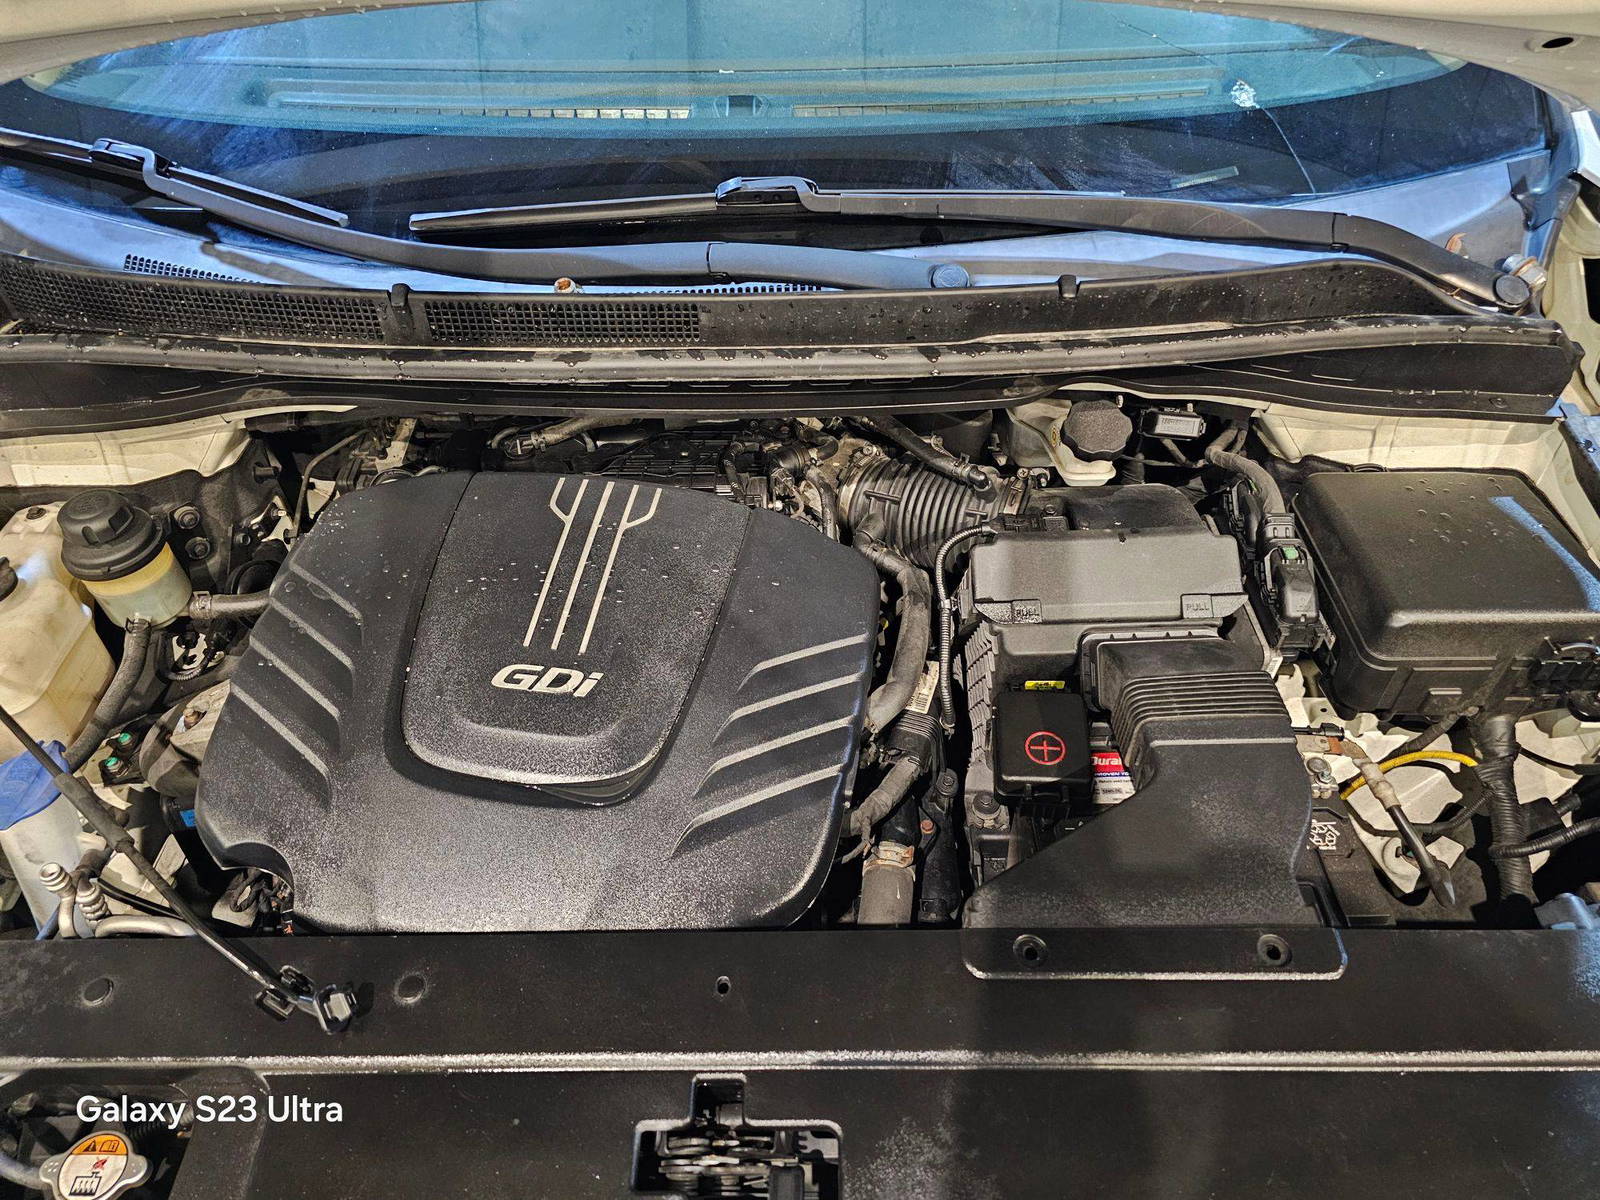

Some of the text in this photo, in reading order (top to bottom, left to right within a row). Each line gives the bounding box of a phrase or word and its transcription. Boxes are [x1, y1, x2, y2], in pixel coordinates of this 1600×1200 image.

[1184, 601, 1210, 612] PULL
[1014, 607, 1040, 618] PULL
[491, 664, 604, 698] GDi
